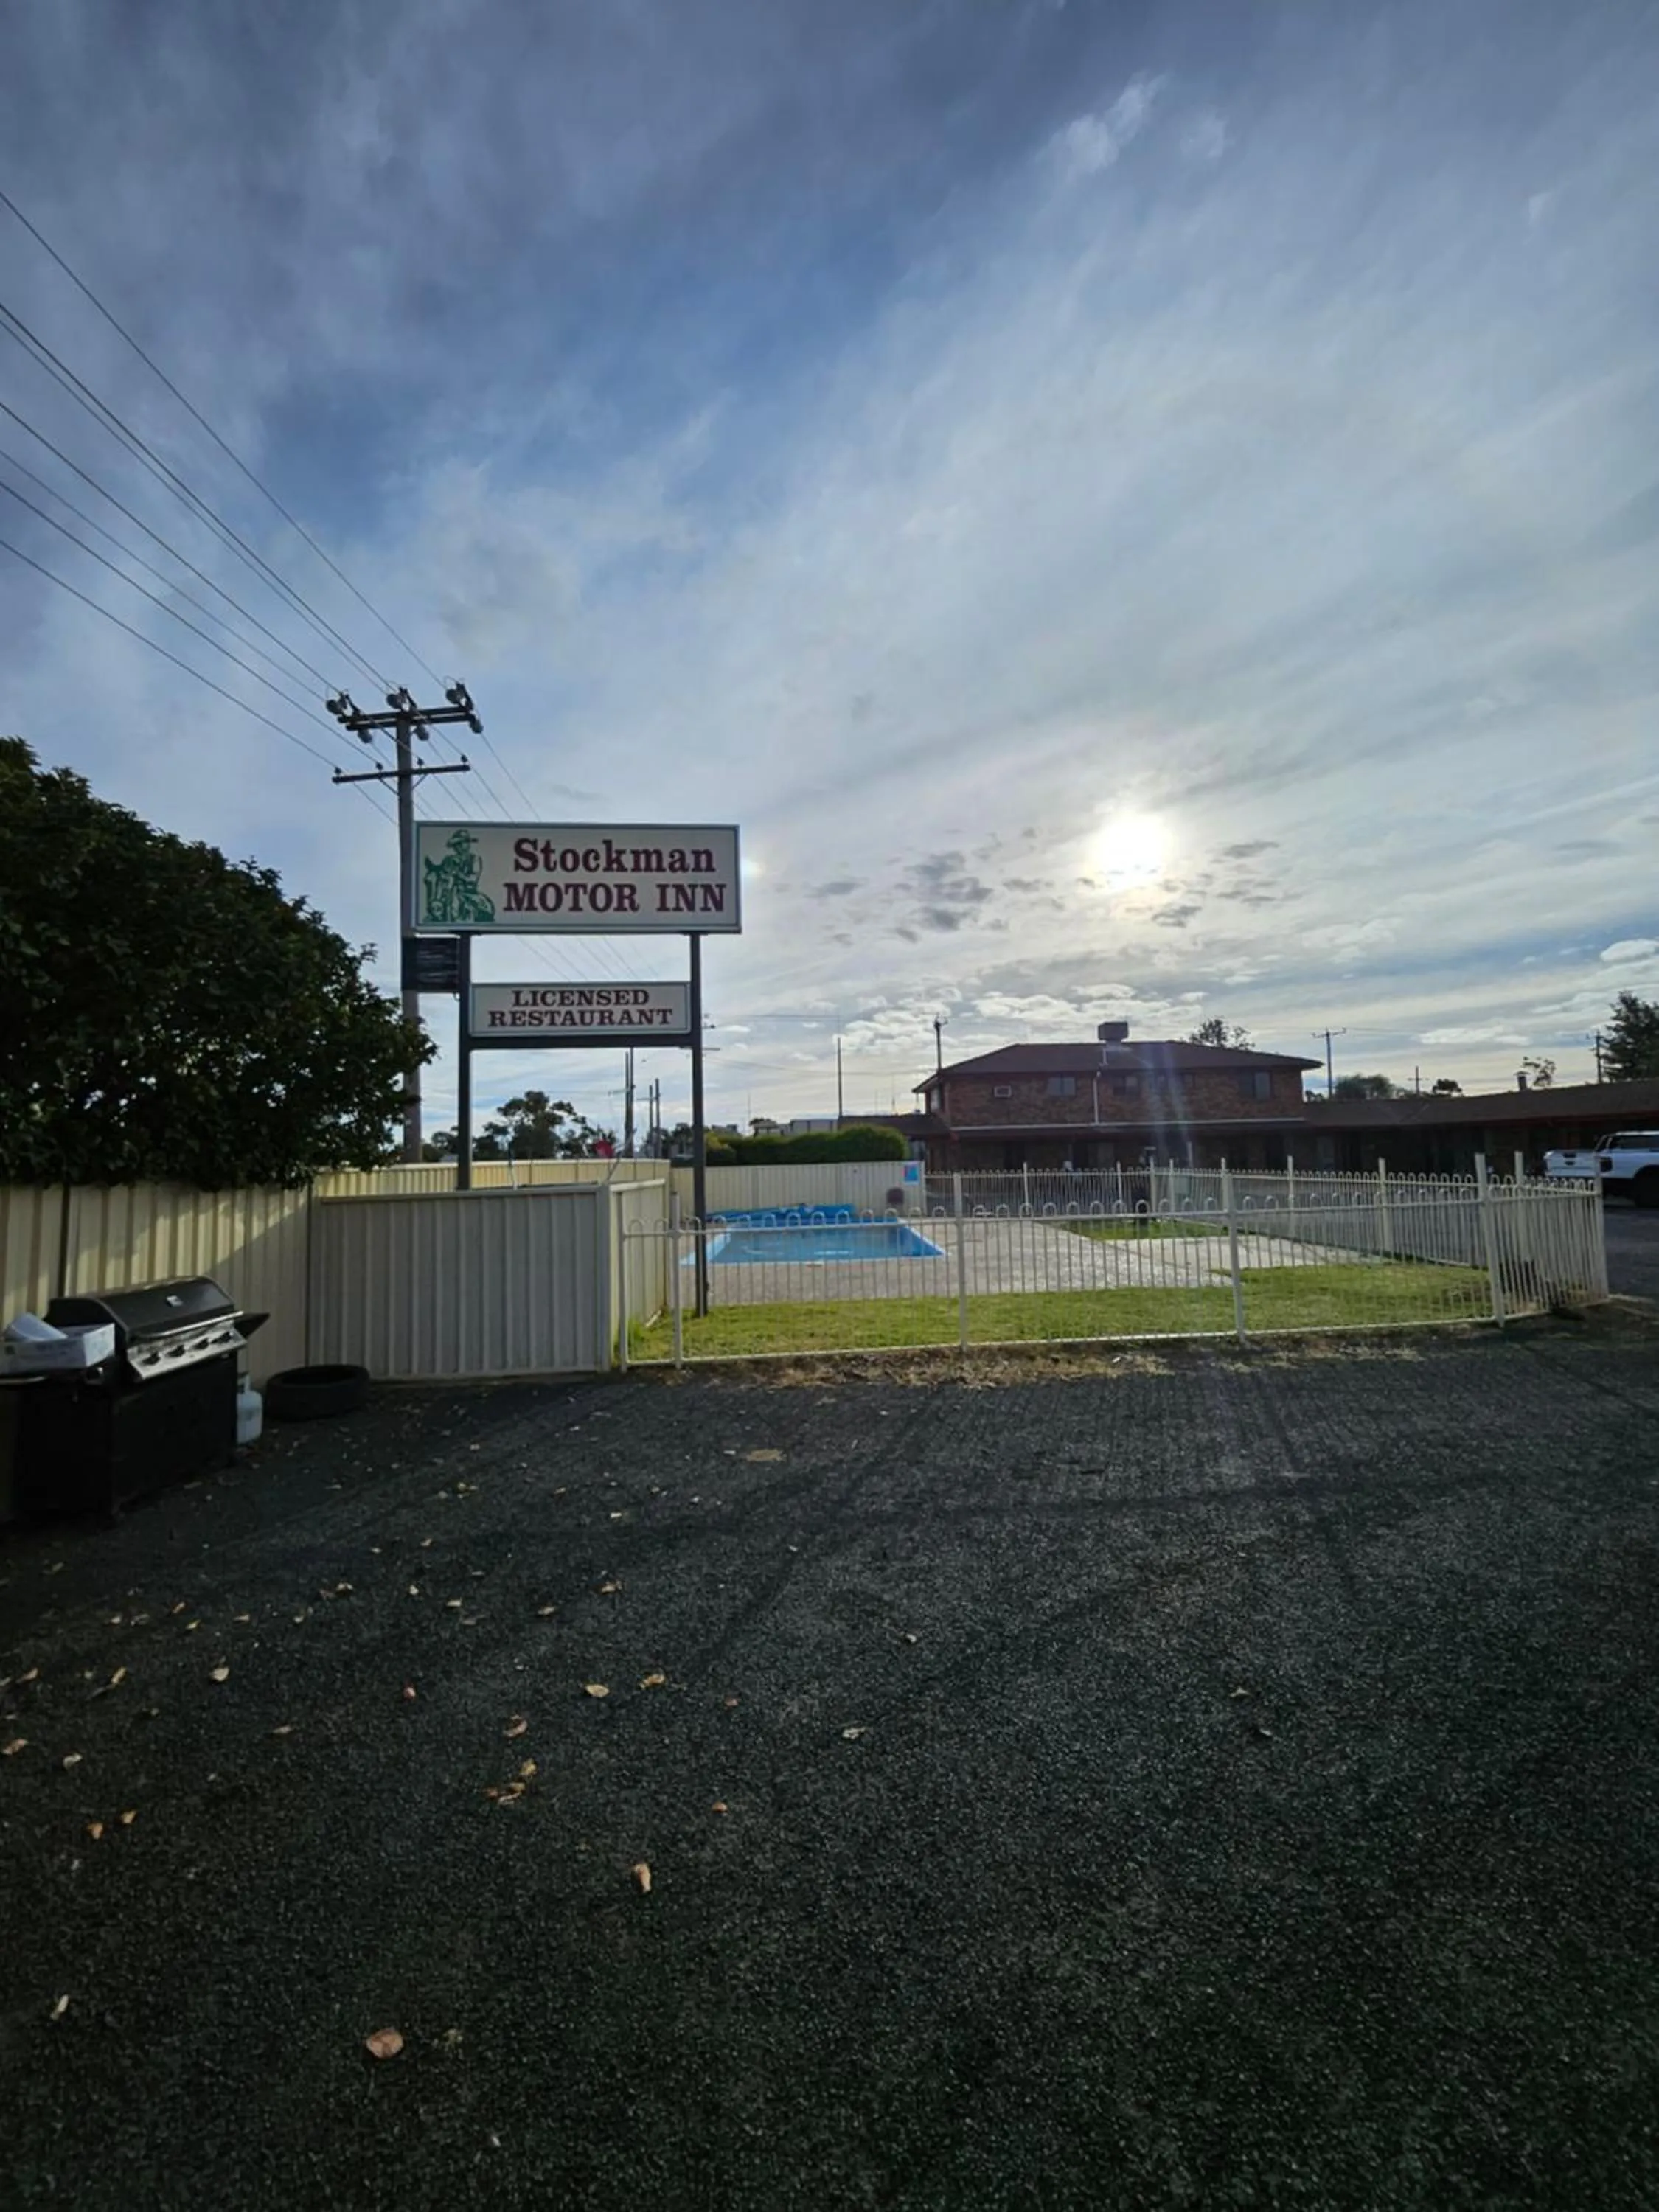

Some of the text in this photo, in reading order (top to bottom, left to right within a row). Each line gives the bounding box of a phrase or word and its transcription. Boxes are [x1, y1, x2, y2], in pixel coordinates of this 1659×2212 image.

[514, 838, 716, 872] Stockman
[504, 883, 726, 913] MOTOR INN
[512, 990, 649, 1006] LICENSED
[487, 1009, 673, 1027] RESTAURANT
